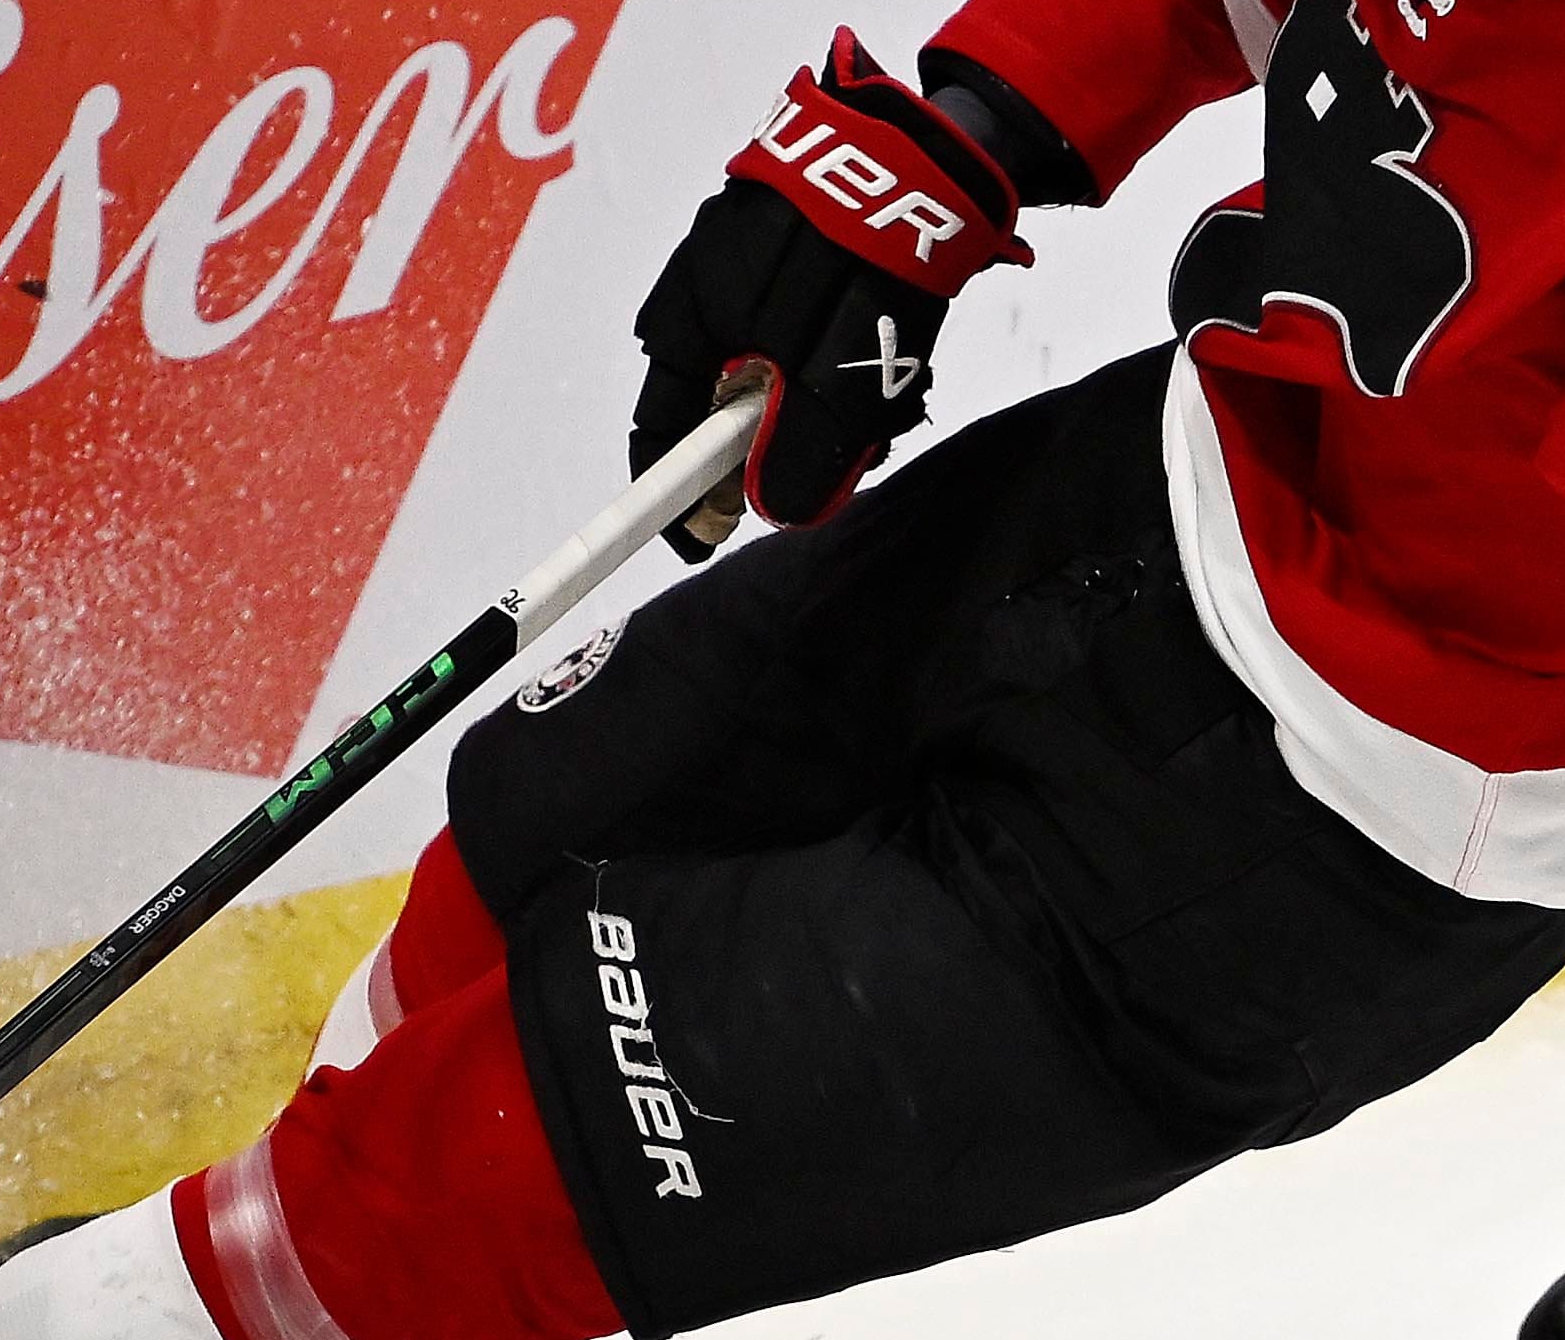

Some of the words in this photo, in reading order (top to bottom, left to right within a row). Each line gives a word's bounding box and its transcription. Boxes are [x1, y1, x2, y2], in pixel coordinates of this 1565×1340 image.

[754, 93, 966, 264] UER
[128, 884, 187, 934] DAGGER
[586, 909, 703, 1201] BAUER
